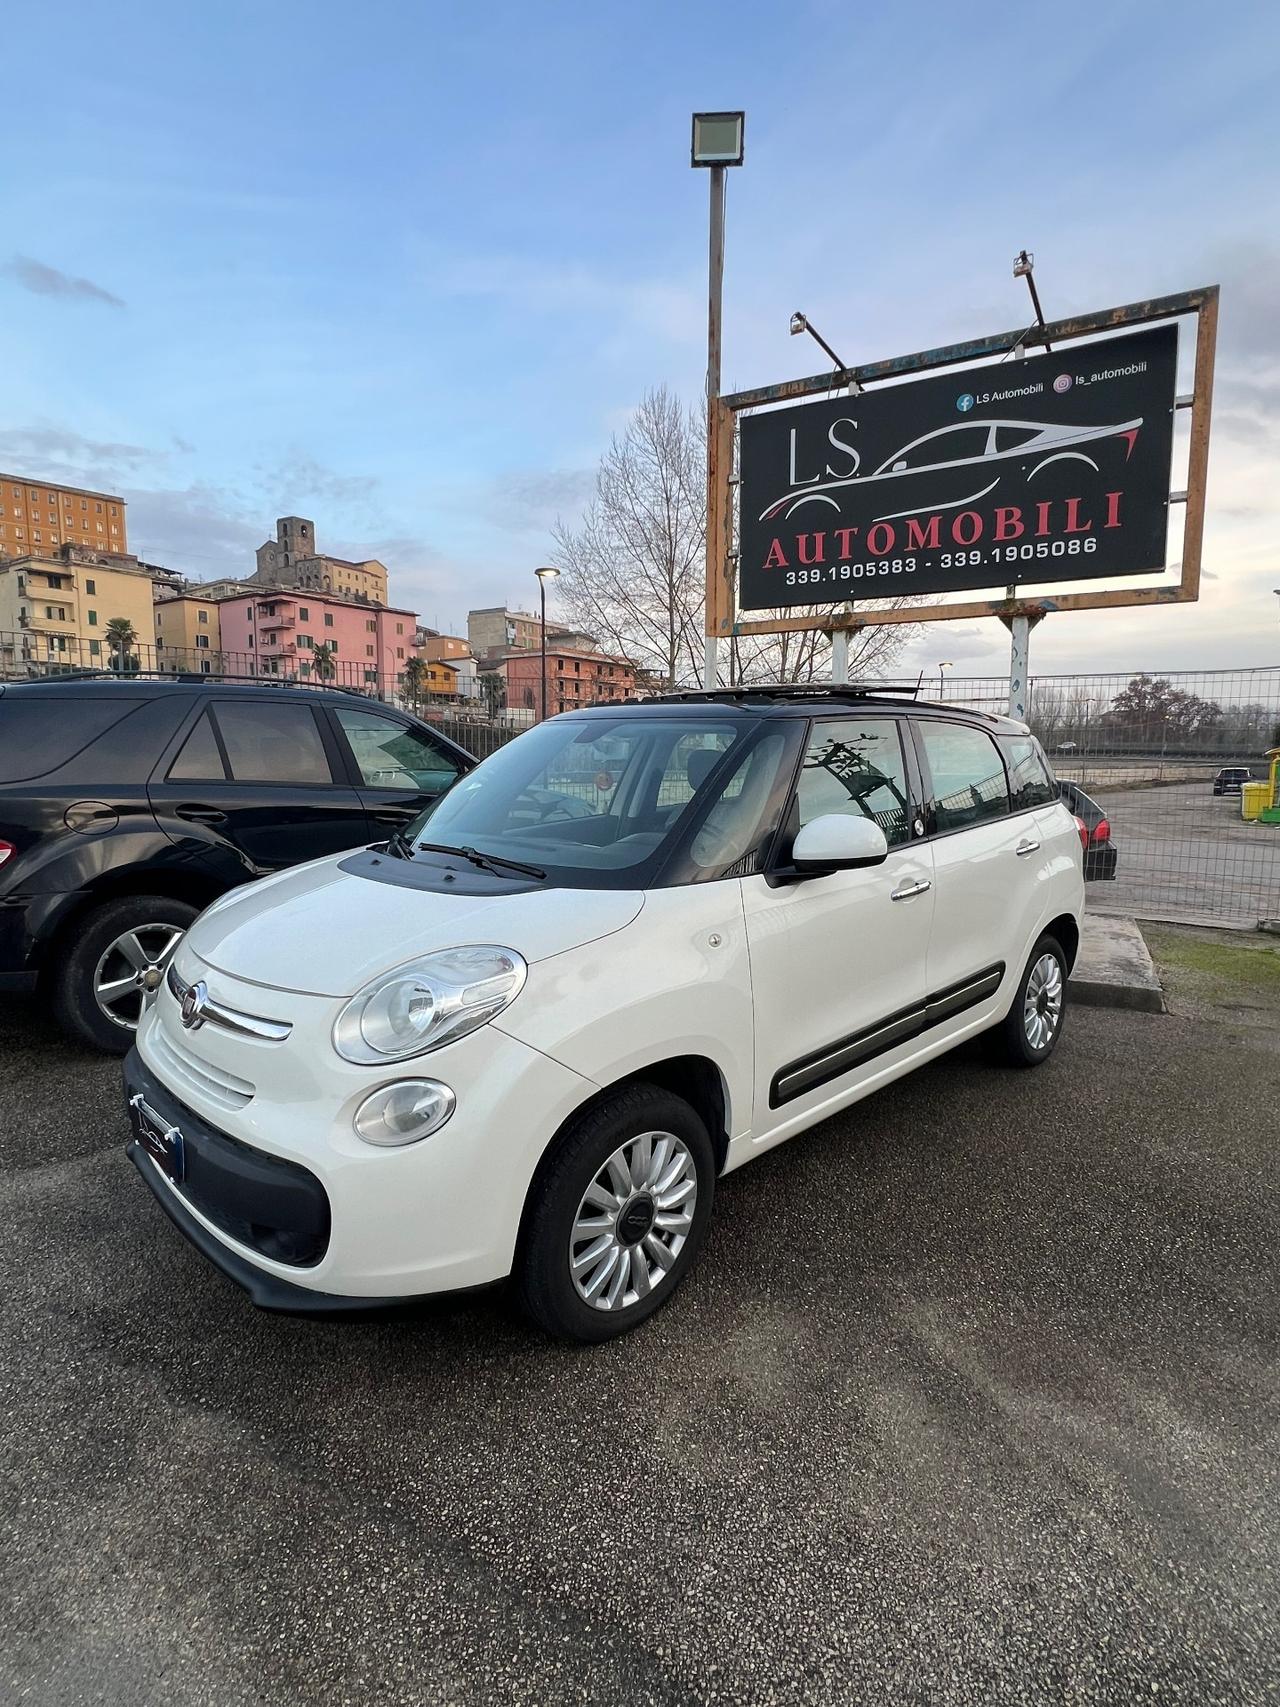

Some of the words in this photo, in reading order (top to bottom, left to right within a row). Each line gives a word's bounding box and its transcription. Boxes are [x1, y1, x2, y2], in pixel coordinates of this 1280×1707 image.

[976, 393, 990, 405] LS
[991, 382, 1044, 401] Automobili
[1075, 361, 1147, 386] ls_automobili
[790, 418, 860, 486] LS
[762, 491, 1124, 569] AUTOMOBILI
[786, 557, 917, 585] 339.1905383
[940, 537, 1097, 569] 339.1905086
